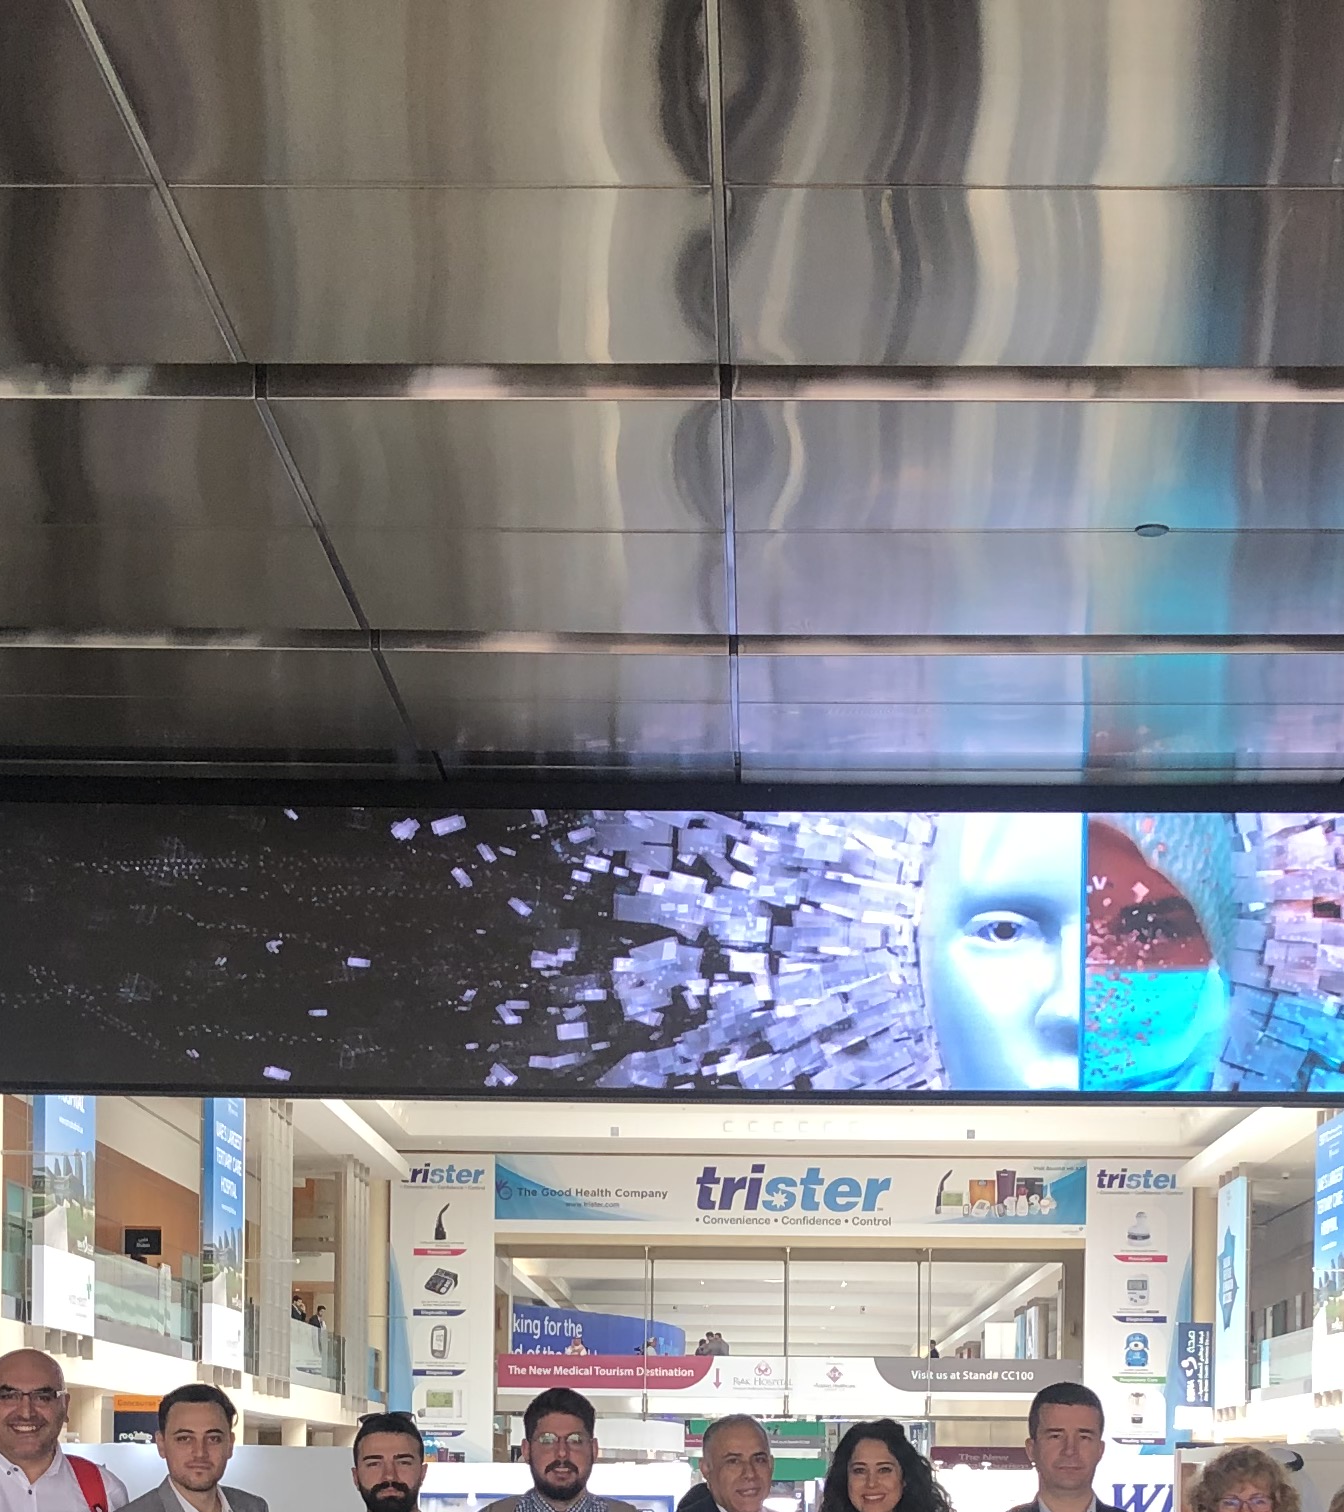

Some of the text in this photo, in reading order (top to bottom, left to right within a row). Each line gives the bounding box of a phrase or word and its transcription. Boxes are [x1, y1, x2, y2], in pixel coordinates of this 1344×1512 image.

[401, 1162, 485, 1185] rister
[517, 1187, 668, 1201] The Good Health Company
[695, 1163, 893, 1213] trister
[702, 1214, 892, 1227] Convenience Confidence Control
[544, 1316, 561, 1337] for
[564, 1318, 583, 1338] the
[508, 1365, 694, 1377] The New Medical Tourism Destination
[911, 1370, 1034, 1381] Visit us at Stand# CC100
[958, 1453, 1009, 1461] The New
